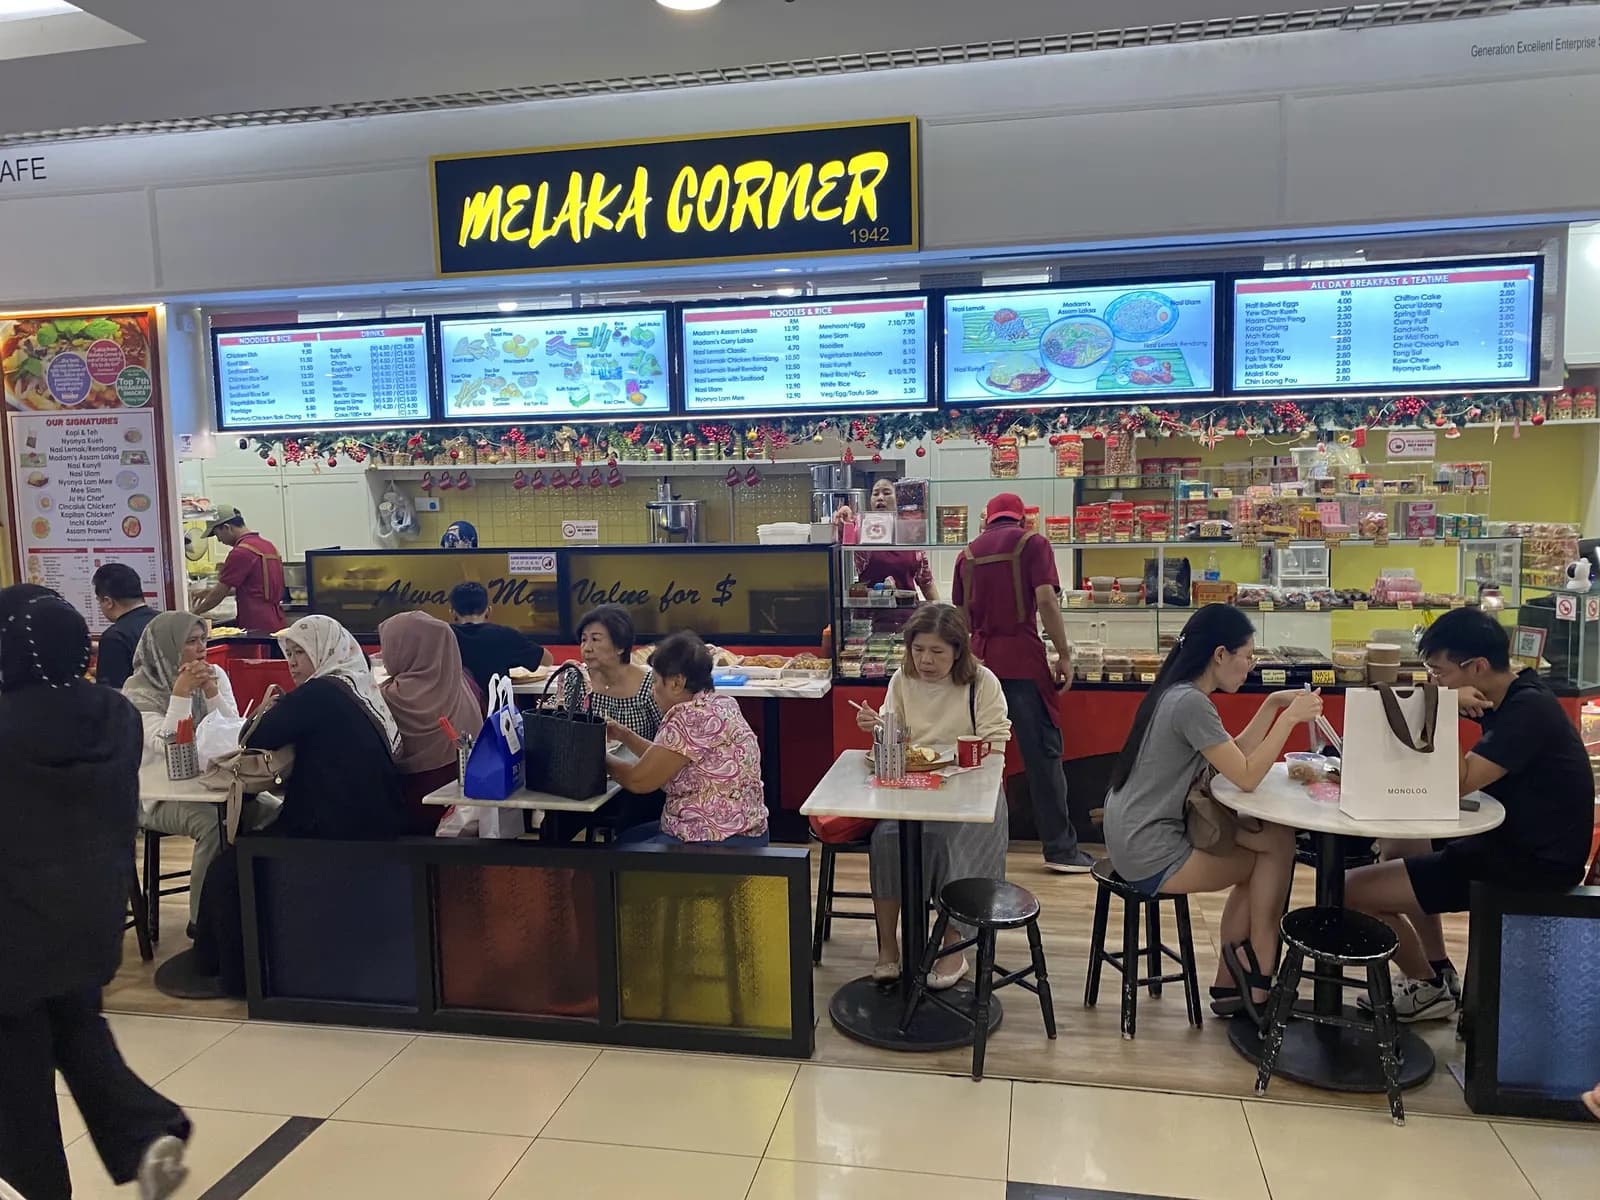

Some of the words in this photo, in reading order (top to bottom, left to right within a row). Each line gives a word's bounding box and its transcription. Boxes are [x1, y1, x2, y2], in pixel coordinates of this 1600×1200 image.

[1472, 44, 1514, 56] Generation
[1518, 40, 1552, 54] Excellent
[1556, 38, 1596, 51] Enterprise
[0, 157, 47, 183] AFE
[458, 165, 653, 250] MELAKA
[667, 151, 890, 234] CORNER
[850, 227, 890, 244] 1942
[1311, 282, 1326, 290] ALL
[1328, 280, 1349, 288] DAY
[1350, 277, 1399, 288] BREAKFAST
[1410, 274, 1448, 284] TEATIME
[770, 308, 806, 318] NOODLES
[119, 378, 135, 386] Top
[136, 377, 149, 385] 7th
[66, 417, 118, 426] SIGNATURES
[374, 579, 449, 606] Alwa
[571, 578, 648, 606] Value
[660, 581, 700, 612] for
